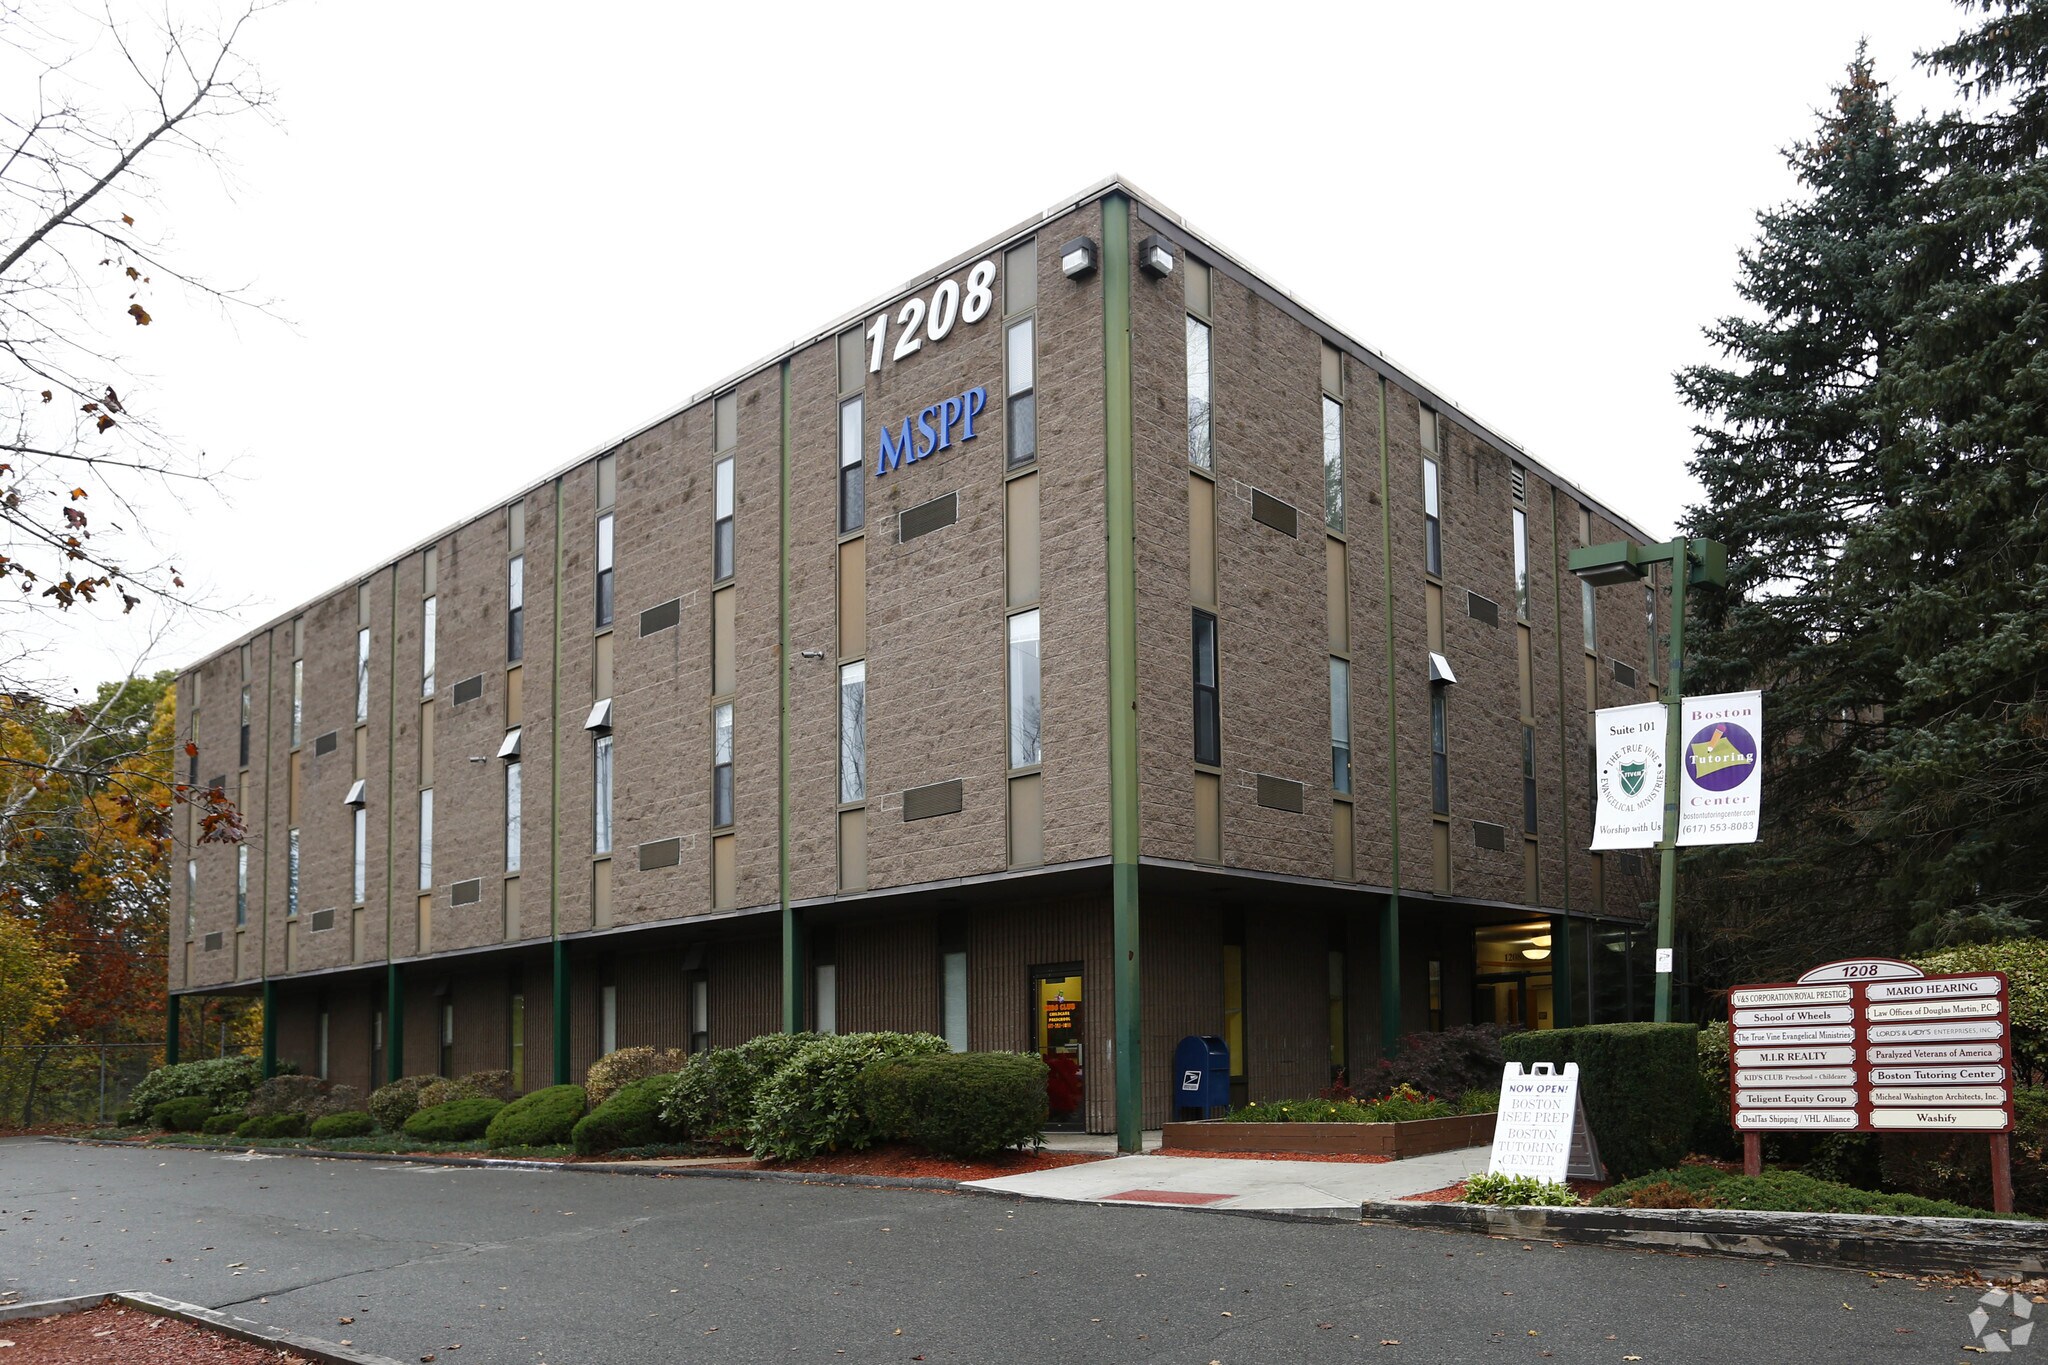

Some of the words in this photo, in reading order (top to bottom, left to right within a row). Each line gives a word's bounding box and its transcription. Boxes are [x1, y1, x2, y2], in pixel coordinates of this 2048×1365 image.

[867, 260, 996, 373] 1208
[875, 386, 986, 476] MSPP
[1692, 708, 1751, 721] Boston
[1610, 725, 1635, 736] Suite
[1639, 722, 1655, 732] 101
[1606, 751, 1622, 767] THE
[1621, 744, 1642, 754] TRUE
[1645, 746, 1660, 762] VINE
[1690, 753, 1753, 764] Tutoring
[1601, 778, 1635, 812] EVANGELICAL
[1637, 770, 1664, 810] MINISTRIES
[1691, 796, 1750, 806] Center
[1684, 809, 1755, 820] bostontutoringcenter.com
[1600, 825, 1630, 835] Worship
[1632, 823, 1648, 832] with
[1651, 821, 1661, 831] Us
[1682, 824, 1706, 834] (617)
[1710, 822, 1754, 832] 553-8083
[1842, 965, 1877, 977] 1208
[1816, 990, 1847, 999] PRESTIGE
[1887, 986, 1923, 996] MARIO
[1927, 983, 1978, 994] HEARING
[1874, 1009, 1887, 1017] Law
[1889, 1008, 1912, 1016] Offices
[1915, 1007, 1921, 1015] of
[1923, 1006, 1950, 1015] Douglas
[1953, 1005, 1979, 1013] Martin,
[1981, 1004, 1994, 1012] P.C.
[1754, 1013, 1783, 1022] School
[1786, 1012, 1795, 1020] of
[1798, 1011, 1831, 1019] Wheels
[1782, 1032, 1817, 1041] Evangelical
[1819, 1031, 1850, 1039] Ministries
[1760, 1053, 1784, 1061] M.I.R
[1788, 1052, 1827, 1060] REALTY
[1876, 1050, 1911, 1060] Paralyzed
[1914, 1049, 1947, 1057] Veterans
[1949, 1049, 1957, 1057] of
[1959, 1048, 1992, 1056] America
[1878, 1071, 1911, 1080] Boston
[1914, 1071, 1957, 1080] Tutoring
[1960, 1070, 1996, 1078] Center
[1537, 1085, 1568, 1093] OPEN!
[1747, 1095, 1782, 1104] Teligent
[1784, 1094, 1814, 1104] Equity
[1816, 1094, 1847, 1104] Group
[1903, 1093, 1943, 1102] Washington
[1512, 1099, 1561, 1109] BOSTON
[1502, 1112, 1531, 1122] ISEE
[1535, 1112, 1569, 1122] PREP
[1743, 1115, 1767, 1123] DealTas
[1769, 1115, 1798, 1124] Shipping
[1917, 1114, 1957, 1123] Washify
[1508, 1129, 1557, 1139] BOSTON
[1499, 1141, 1564, 1153] TUTORING
[1502, 1155, 1554, 1166] CENTER
